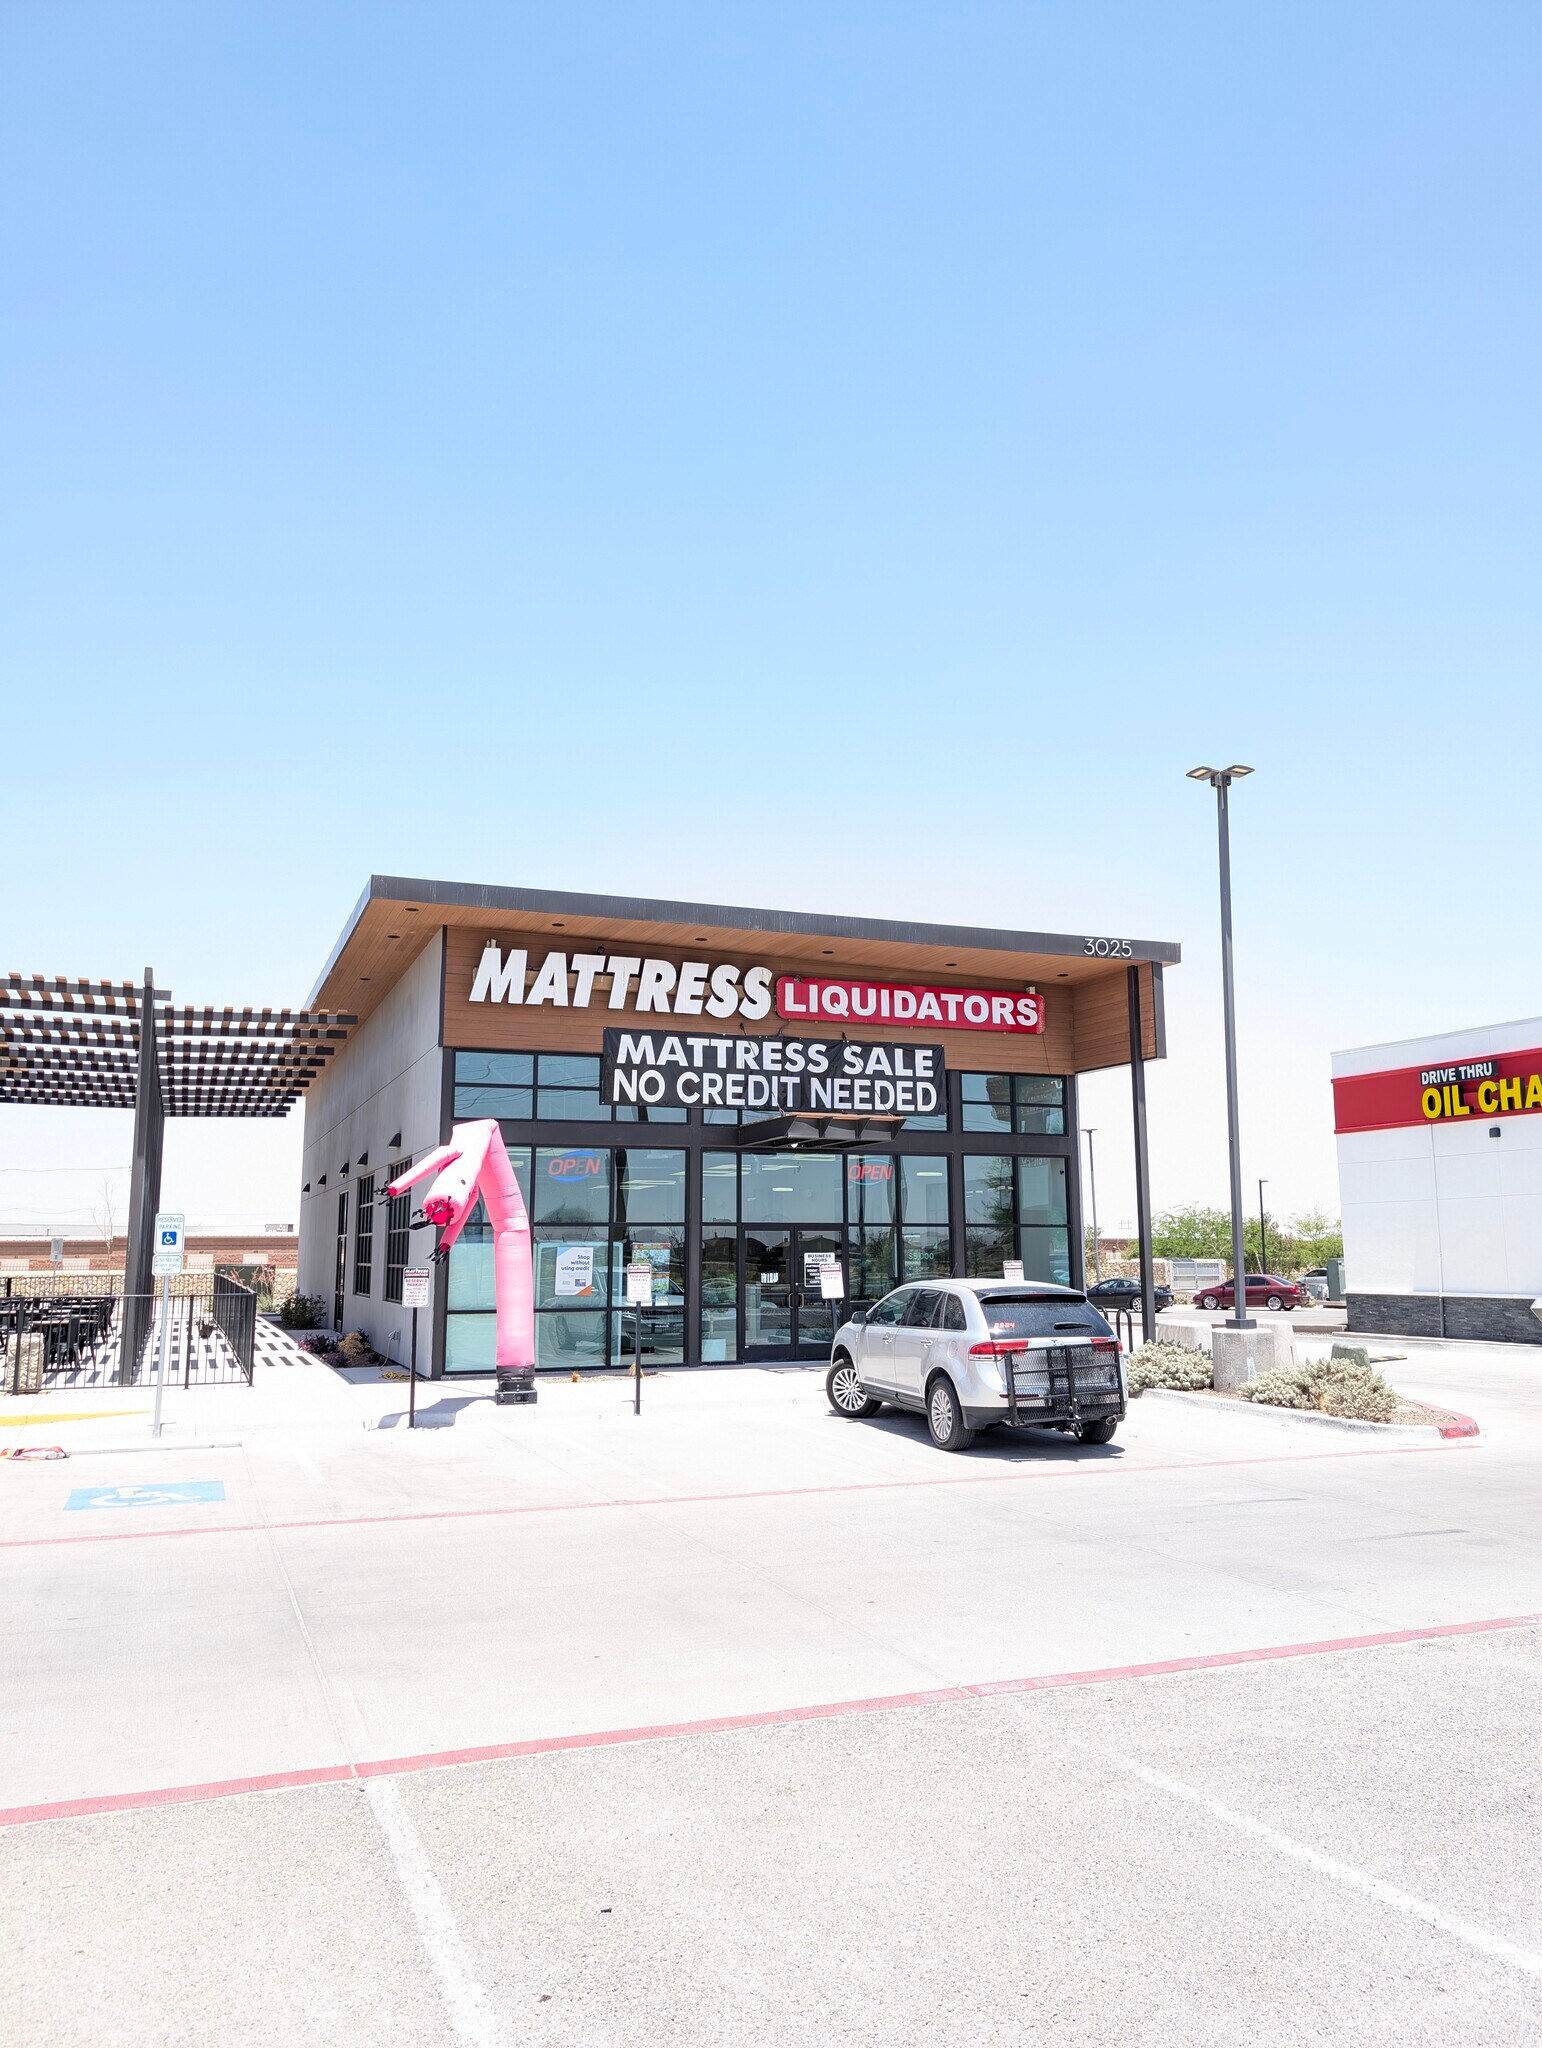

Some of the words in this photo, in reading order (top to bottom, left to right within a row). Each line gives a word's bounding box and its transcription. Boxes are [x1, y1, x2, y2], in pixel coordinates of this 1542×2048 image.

[1083, 937, 1133, 957] 3025
[469, 947, 774, 1021] MATTRESS
[784, 983, 1038, 1027] LIQUIDATORS
[616, 1033, 829, 1074] MATTRESS
[842, 1043, 934, 1078] SALE
[1421, 1067, 1457, 1086] DRIVE
[1458, 1061, 1493, 1080] THRU
[612, 1068, 666, 1103] NO
[676, 1071, 801, 1107] CREDIT
[810, 1076, 938, 1112] NEEDED
[1421, 1084, 1471, 1119] OIL
[547, 1158, 602, 1176] OPEN
[847, 1164, 894, 1181] OPEN
